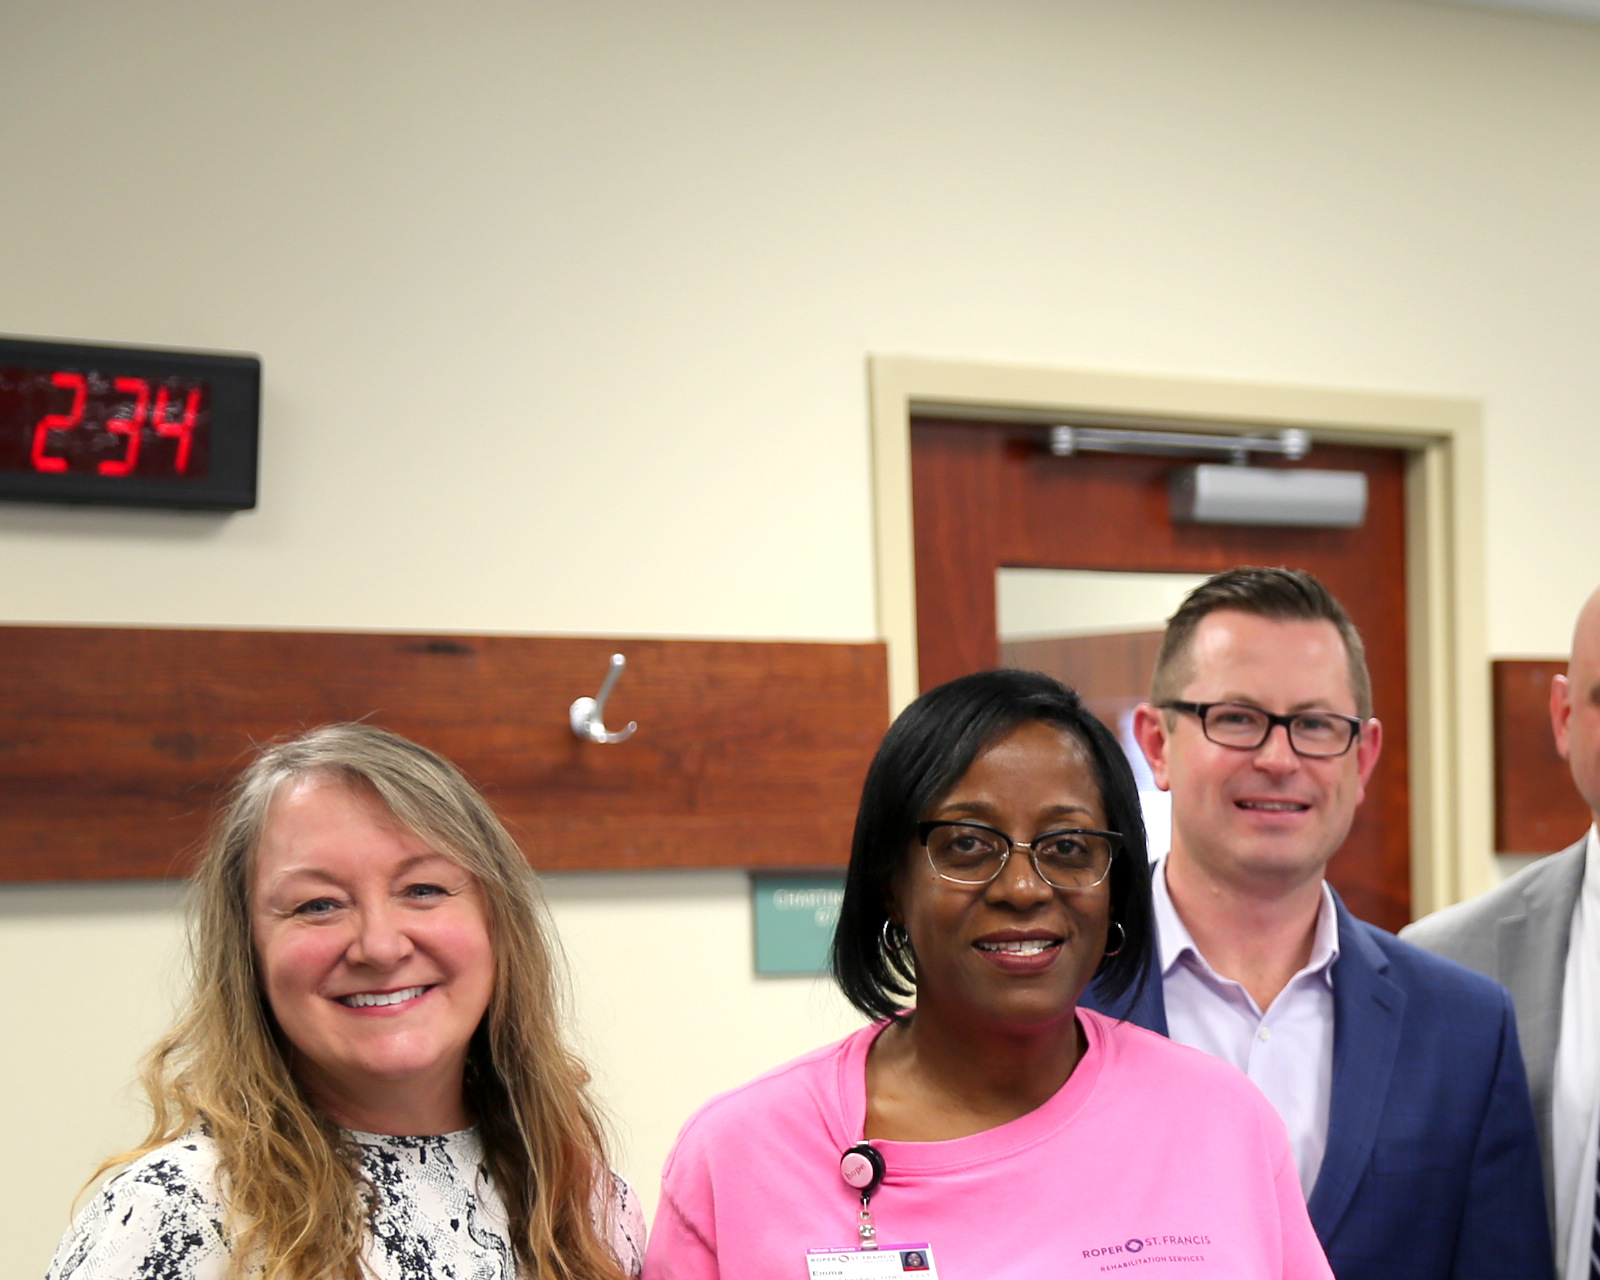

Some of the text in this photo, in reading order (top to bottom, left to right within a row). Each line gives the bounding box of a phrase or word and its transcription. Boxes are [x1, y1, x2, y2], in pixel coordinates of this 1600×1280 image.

[844, 1163, 866, 1180] hope
[1082, 1235, 1211, 1259] ROPER ST. FRANCIS
[1100, 1255, 1205, 1272] REHABILITATION SERVICES
